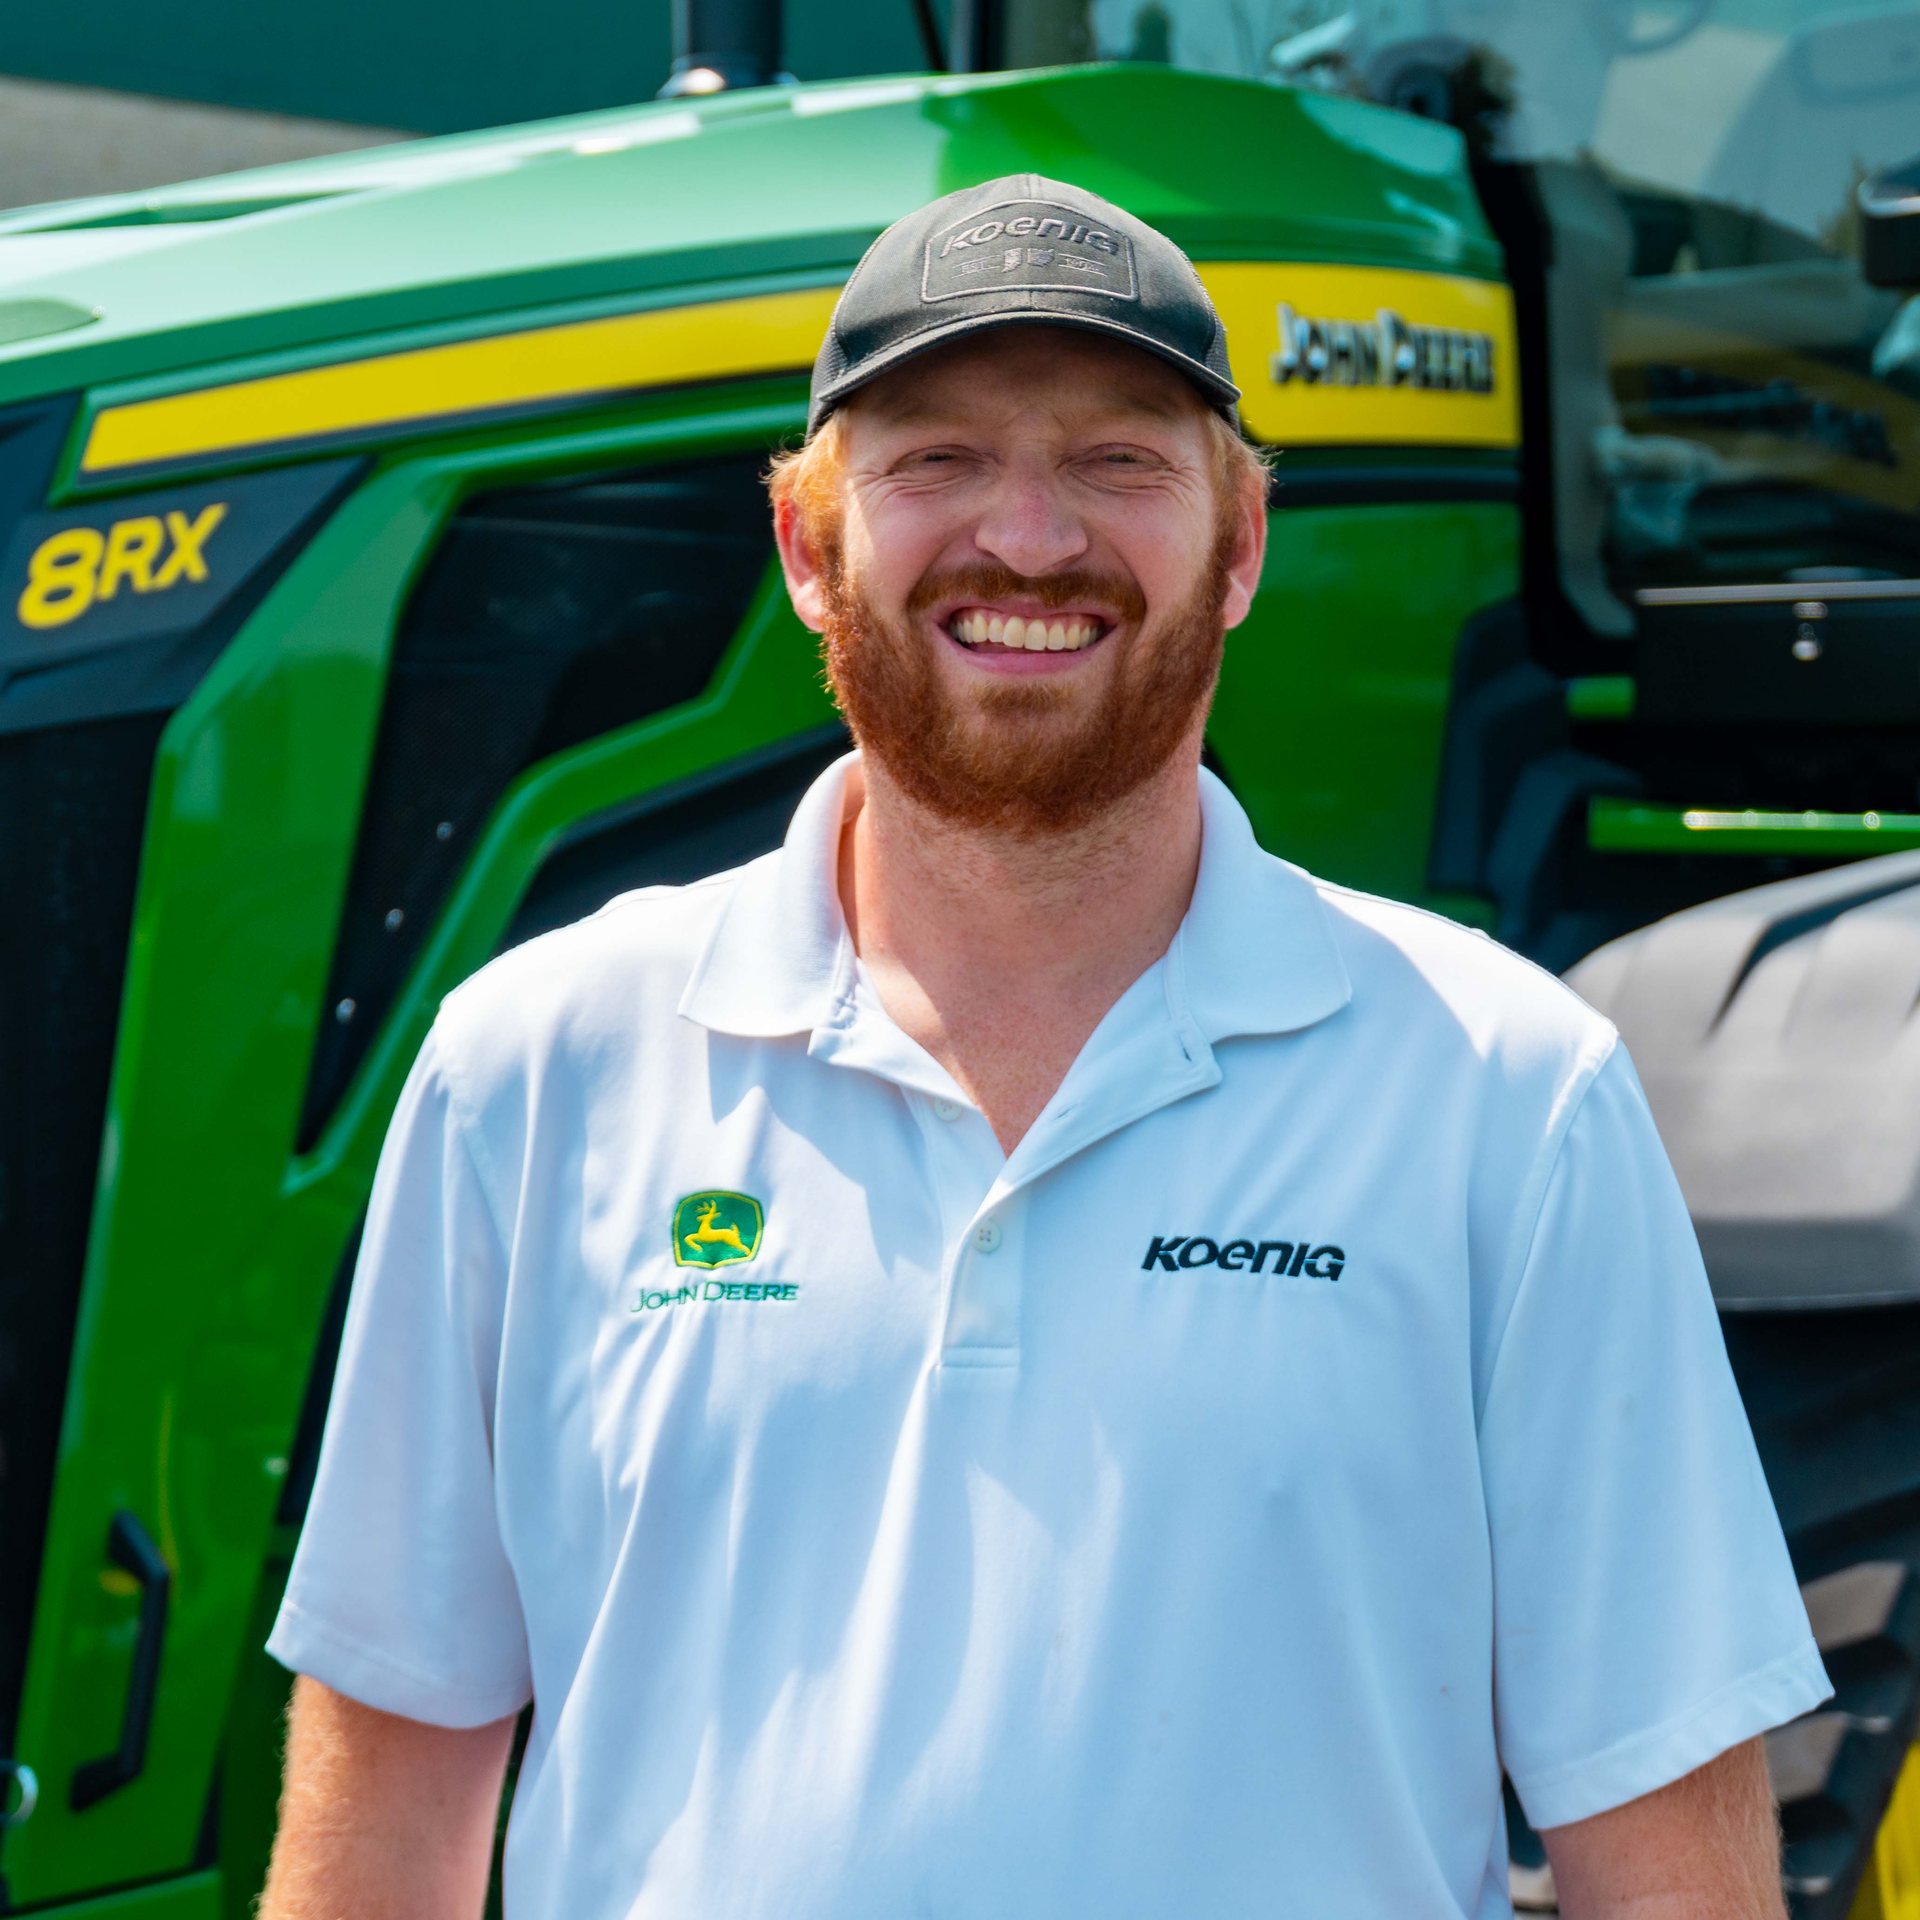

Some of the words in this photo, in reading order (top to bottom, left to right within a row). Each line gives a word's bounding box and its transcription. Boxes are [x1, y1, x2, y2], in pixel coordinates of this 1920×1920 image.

[1268, 302, 1377, 386] JOHN
[1376, 307, 1494, 393] DEERE
[17, 502, 227, 629] 8RX
[630, 1284, 698, 1313] JOHN
[703, 1281, 800, 1301] DEERE
